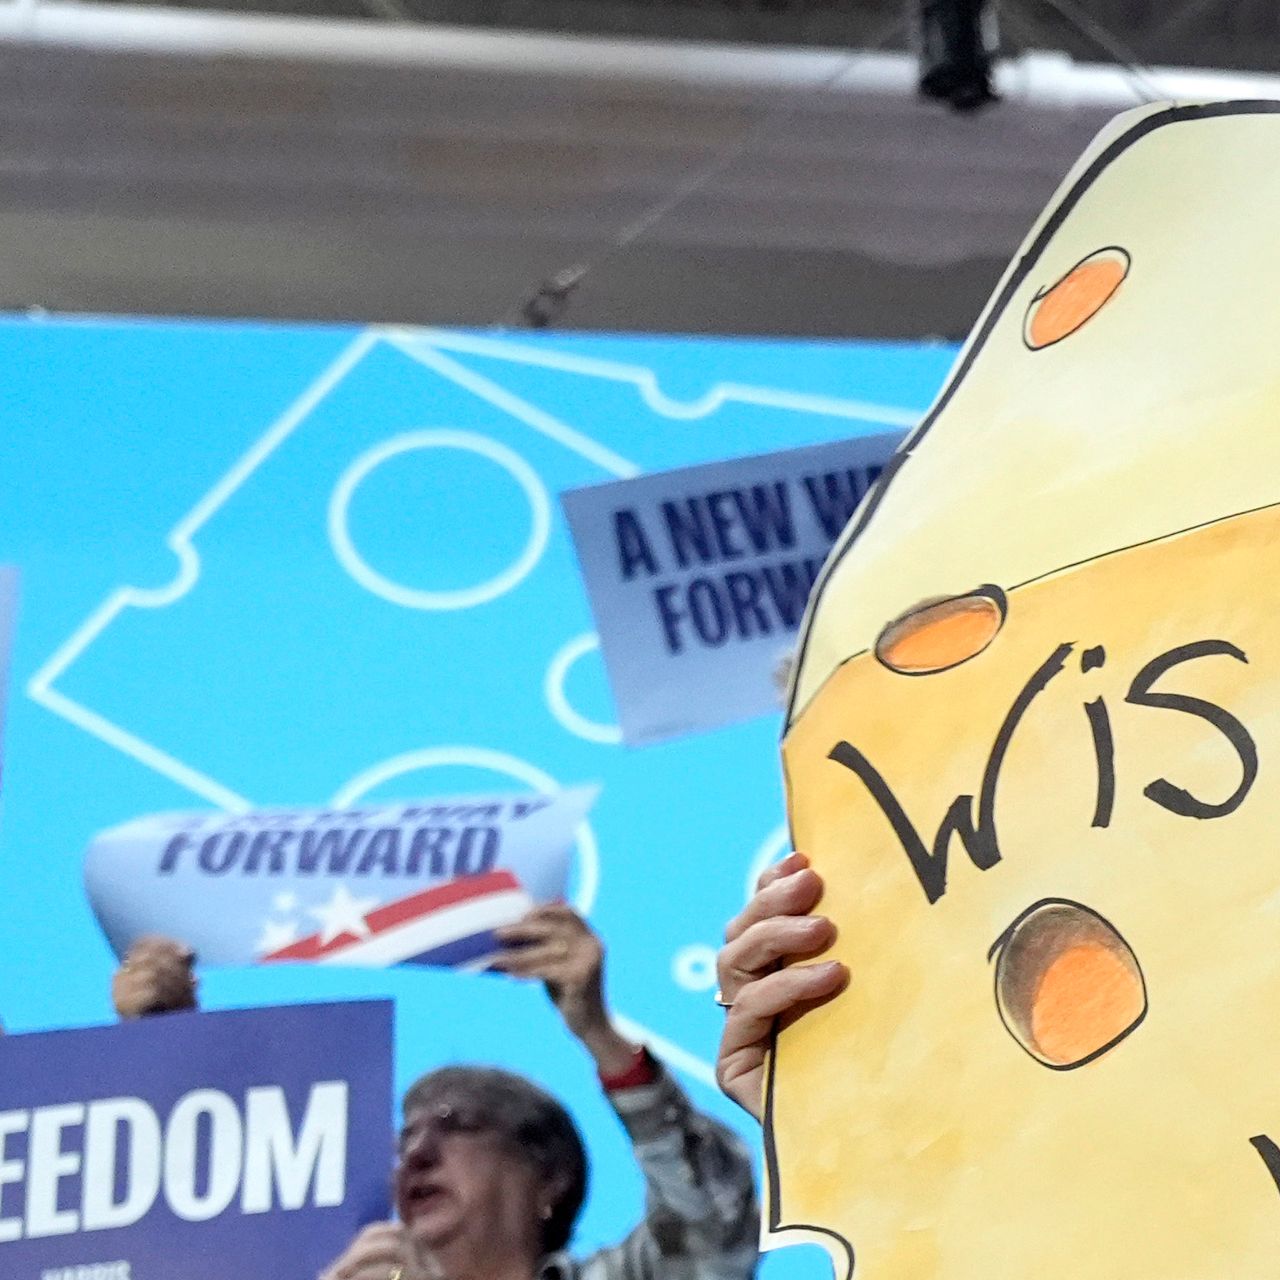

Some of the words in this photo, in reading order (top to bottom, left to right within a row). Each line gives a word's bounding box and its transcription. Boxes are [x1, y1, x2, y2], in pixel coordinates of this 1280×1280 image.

[612, 508, 661, 582] A
[662, 481, 796, 570] NEW
[156, 825, 502, 876] FORWARD
